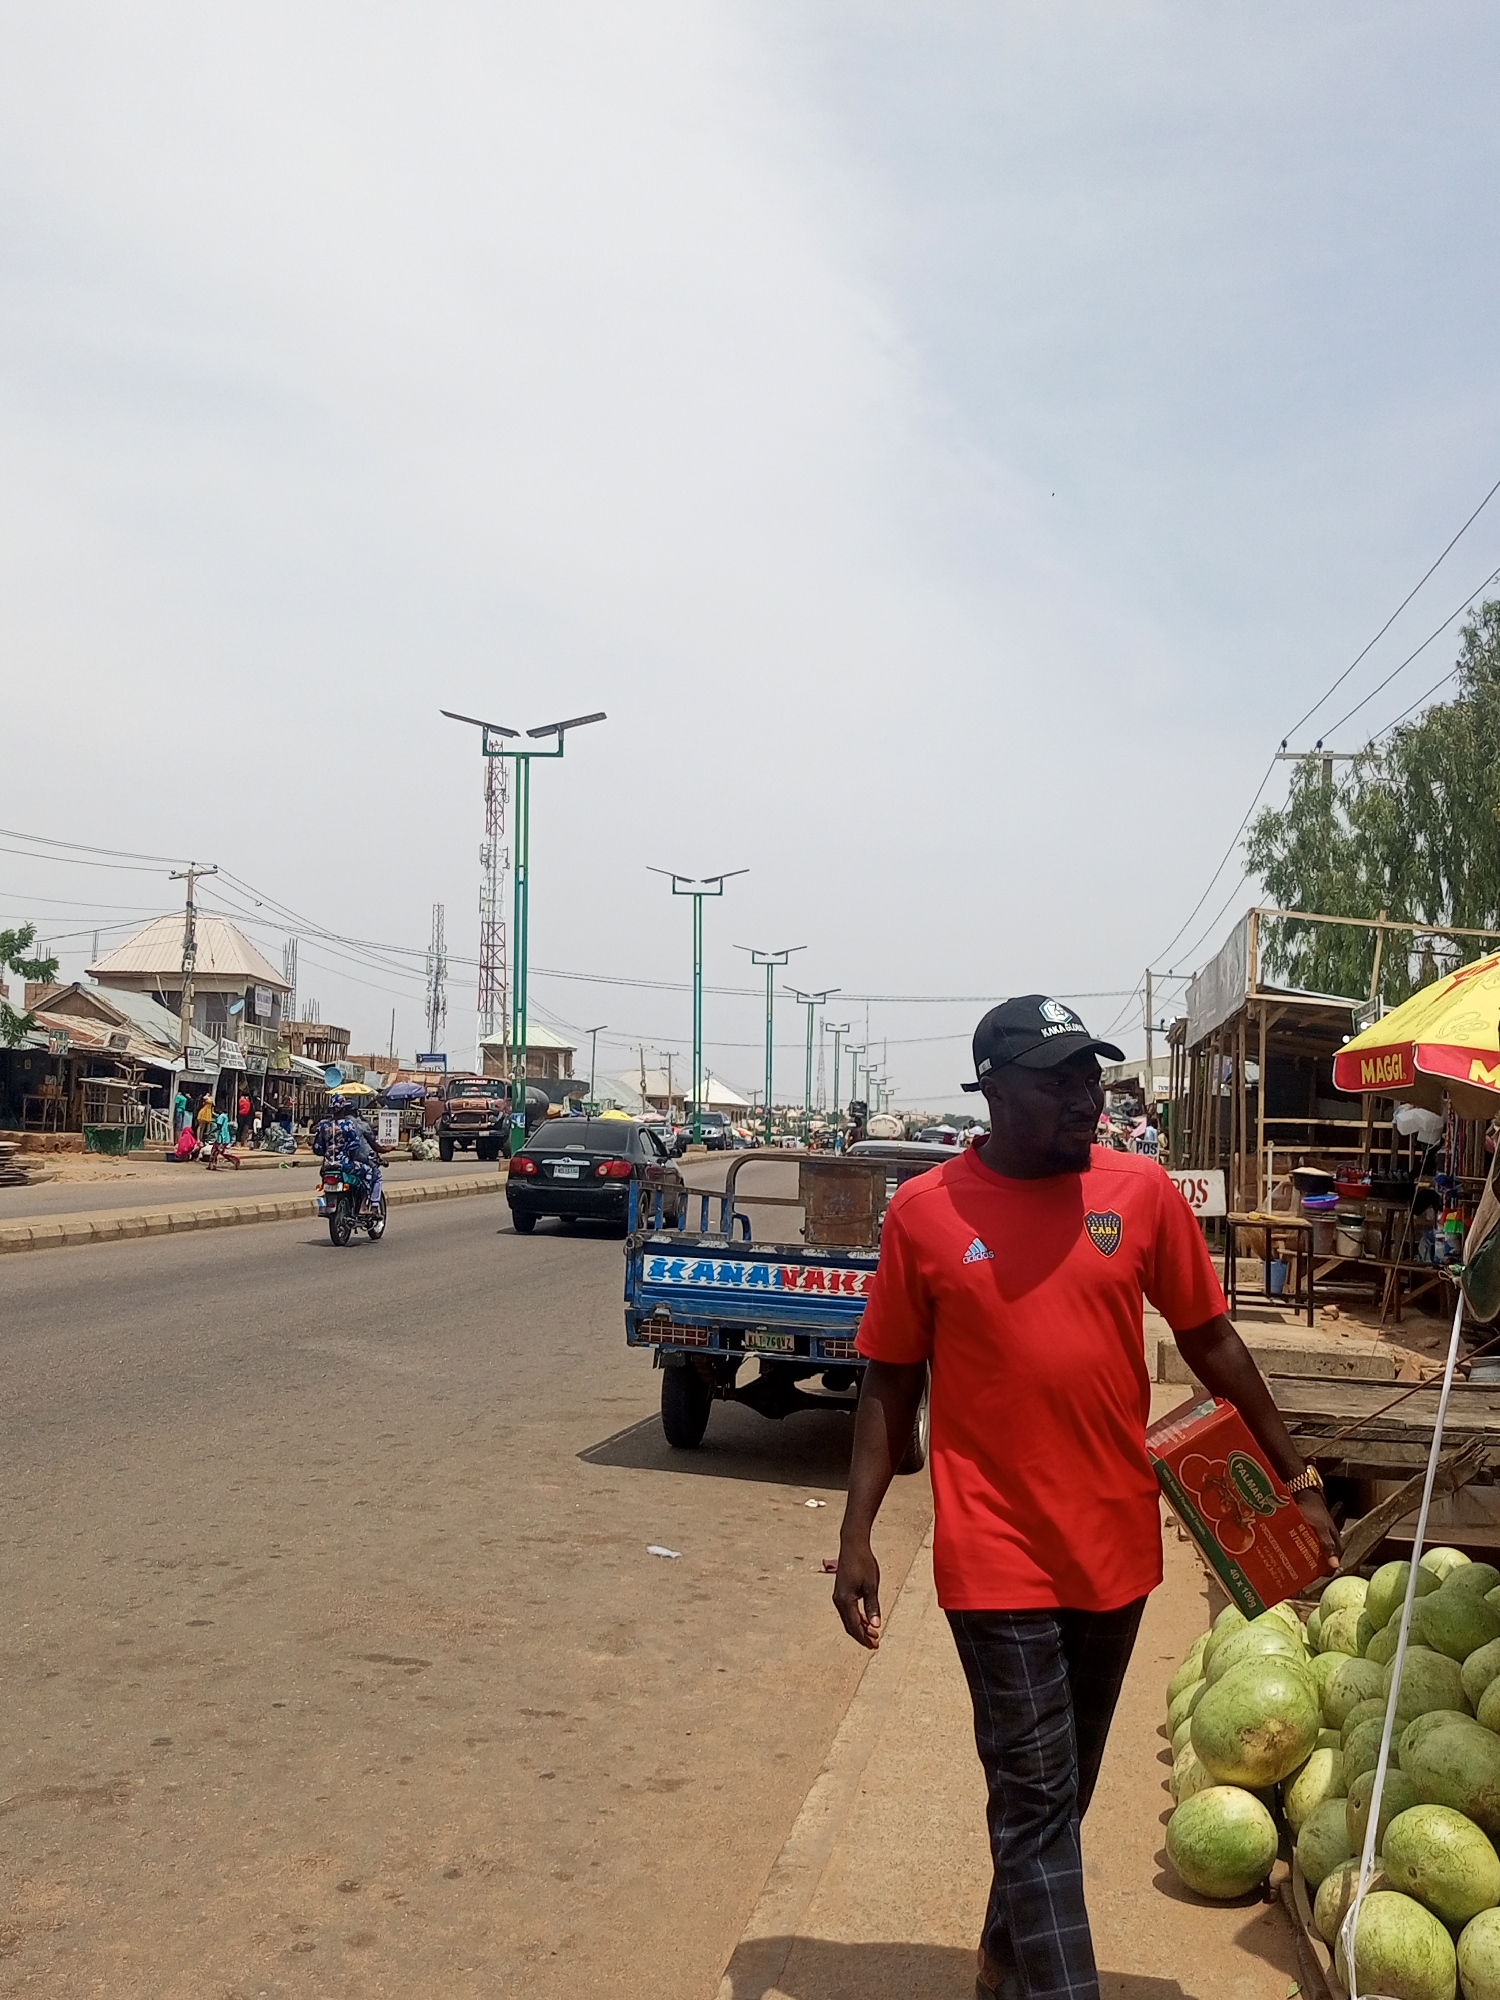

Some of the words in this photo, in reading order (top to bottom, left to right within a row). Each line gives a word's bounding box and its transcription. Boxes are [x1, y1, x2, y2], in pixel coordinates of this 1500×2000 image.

[1041, 1024, 1066, 1038] KAKA
[1361, 1053, 1402, 1085] MAGGI
[1136, 1142, 1158, 1155] POS
[1090, 1226, 1118, 1236] CABJ
[962, 1250, 995, 1264] adidas
[1235, 1462, 1268, 1508] PALMARK
[1228, 1567, 1241, 1580] 40
[1235, 1580, 1244, 1588] x
[1239, 1586, 1258, 1609] 100g
